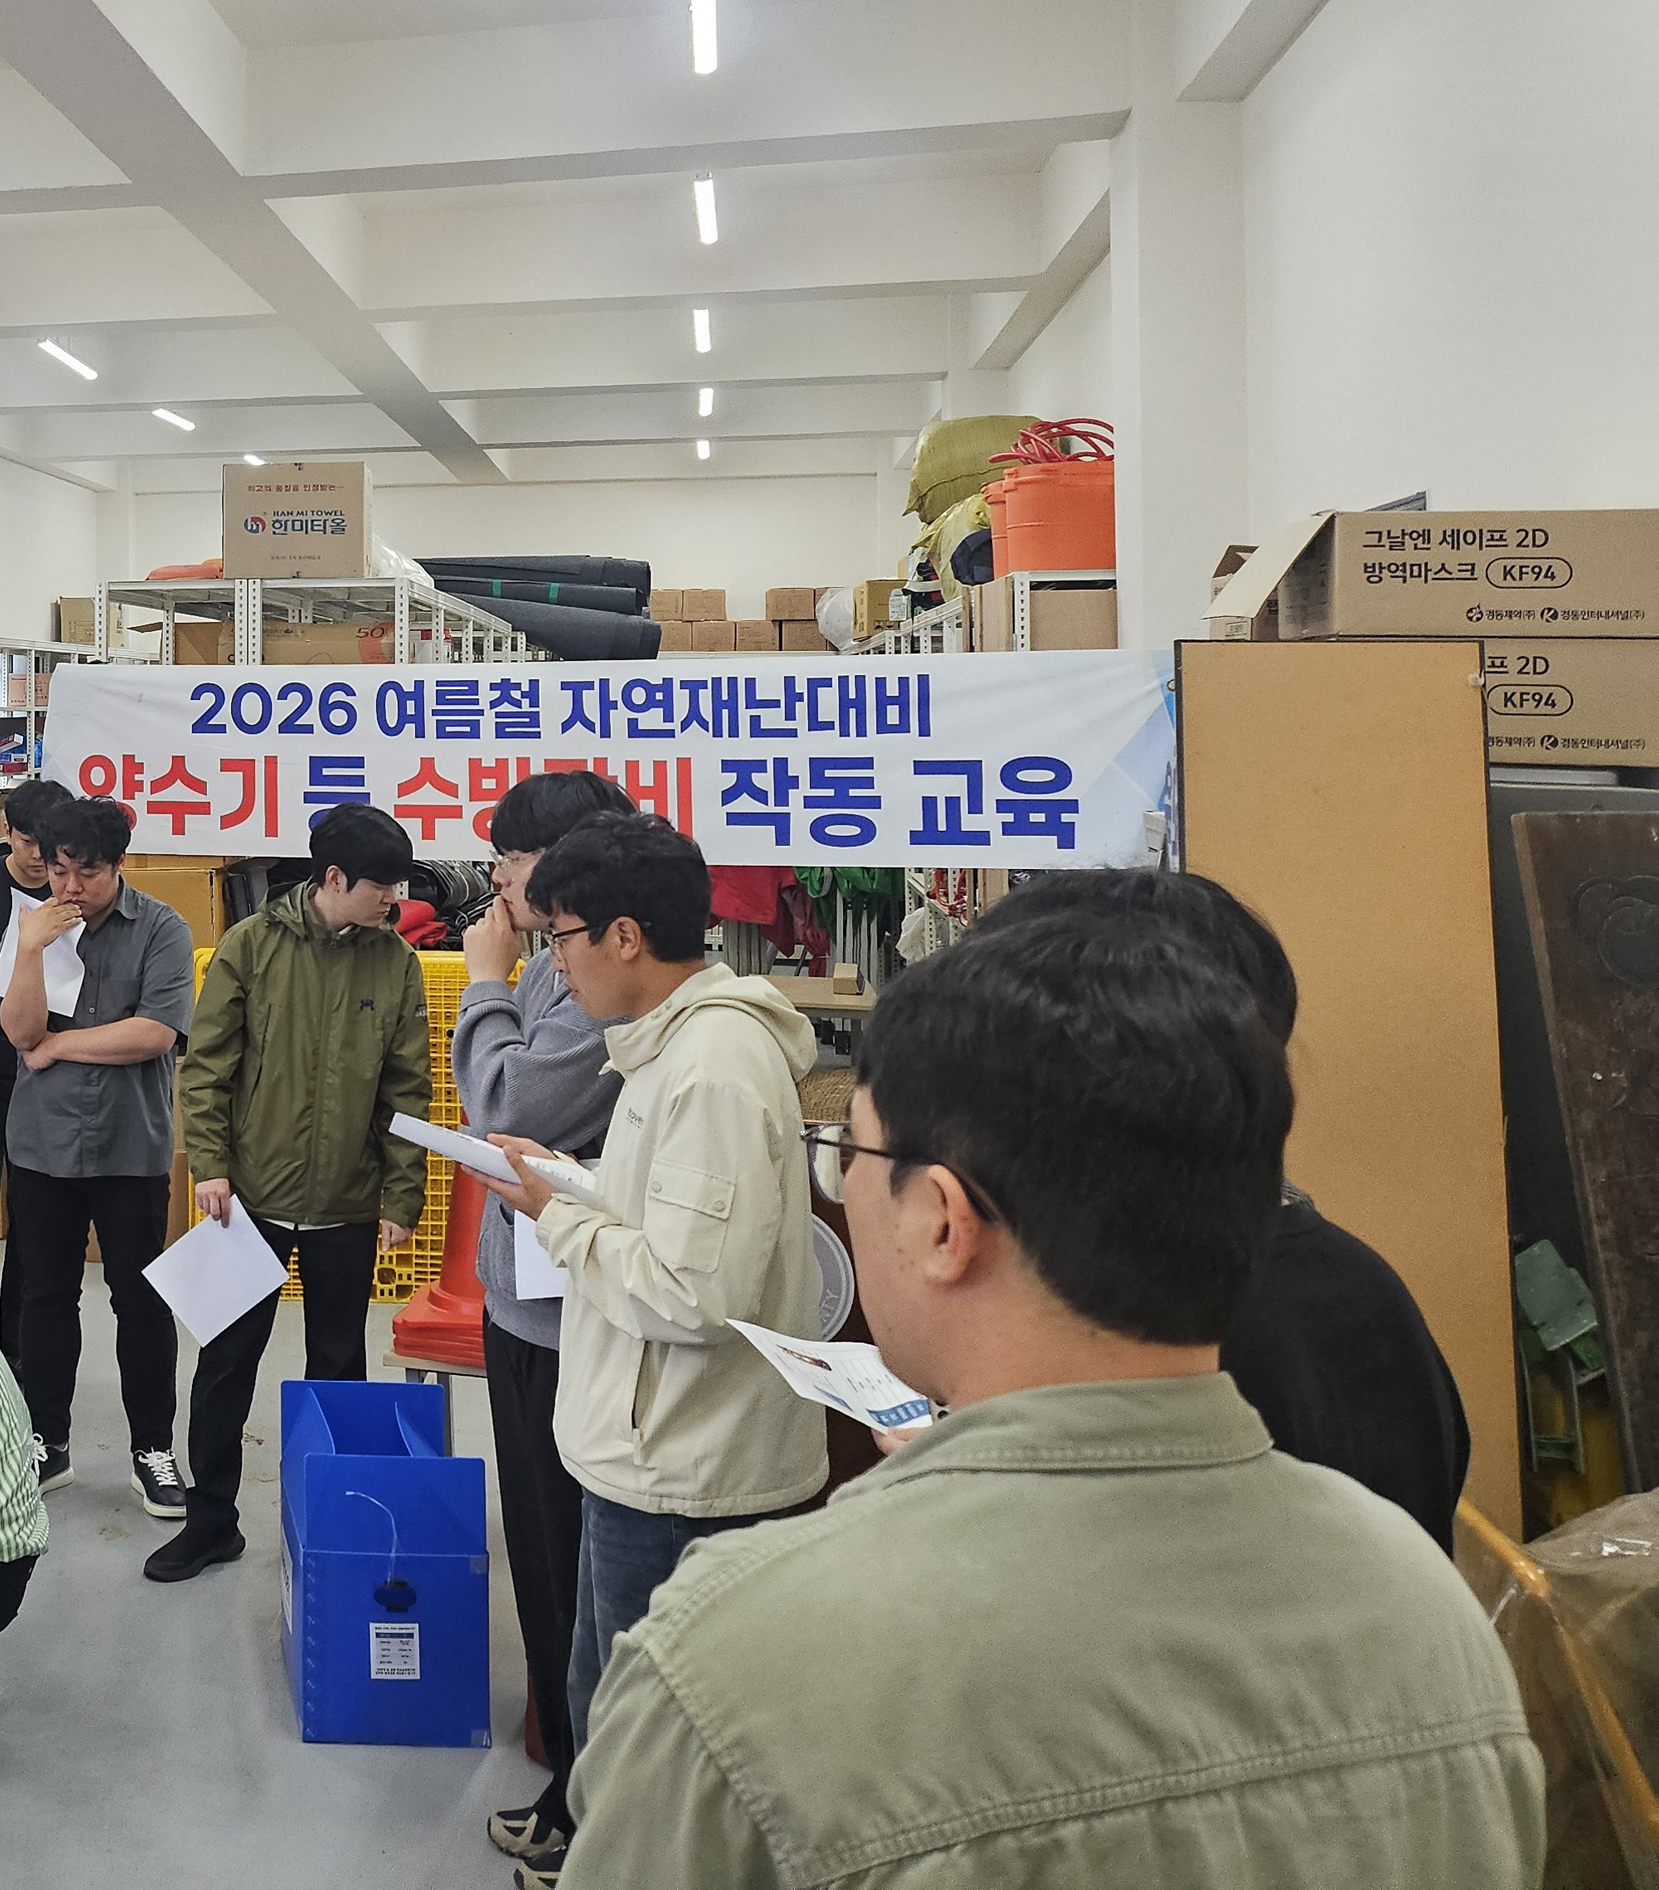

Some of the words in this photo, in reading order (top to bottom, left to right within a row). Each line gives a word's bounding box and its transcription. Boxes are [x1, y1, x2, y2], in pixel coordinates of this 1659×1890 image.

[311, 509, 345, 517] TOWEL
[272, 517, 347, 535] 한미타올
[1362, 528, 1432, 551] 그날엔
[1438, 527, 1508, 551] 세이프
[1515, 528, 1549, 549] 2D
[1363, 561, 1478, 585] 방역마스크
[1501, 563, 1557, 583] KF94
[355, 627, 385, 639] 50
[1516, 655, 1549, 675] 2D
[190, 682, 359, 735] 2026
[375, 677, 542, 740] 여름철
[560, 673, 932, 739] 자연재난대비
[1502, 690, 1557, 710] KF94
[77, 753, 279, 838] 양수기
[721, 756, 883, 849] 작동
[908, 755, 1080, 850] 교육
